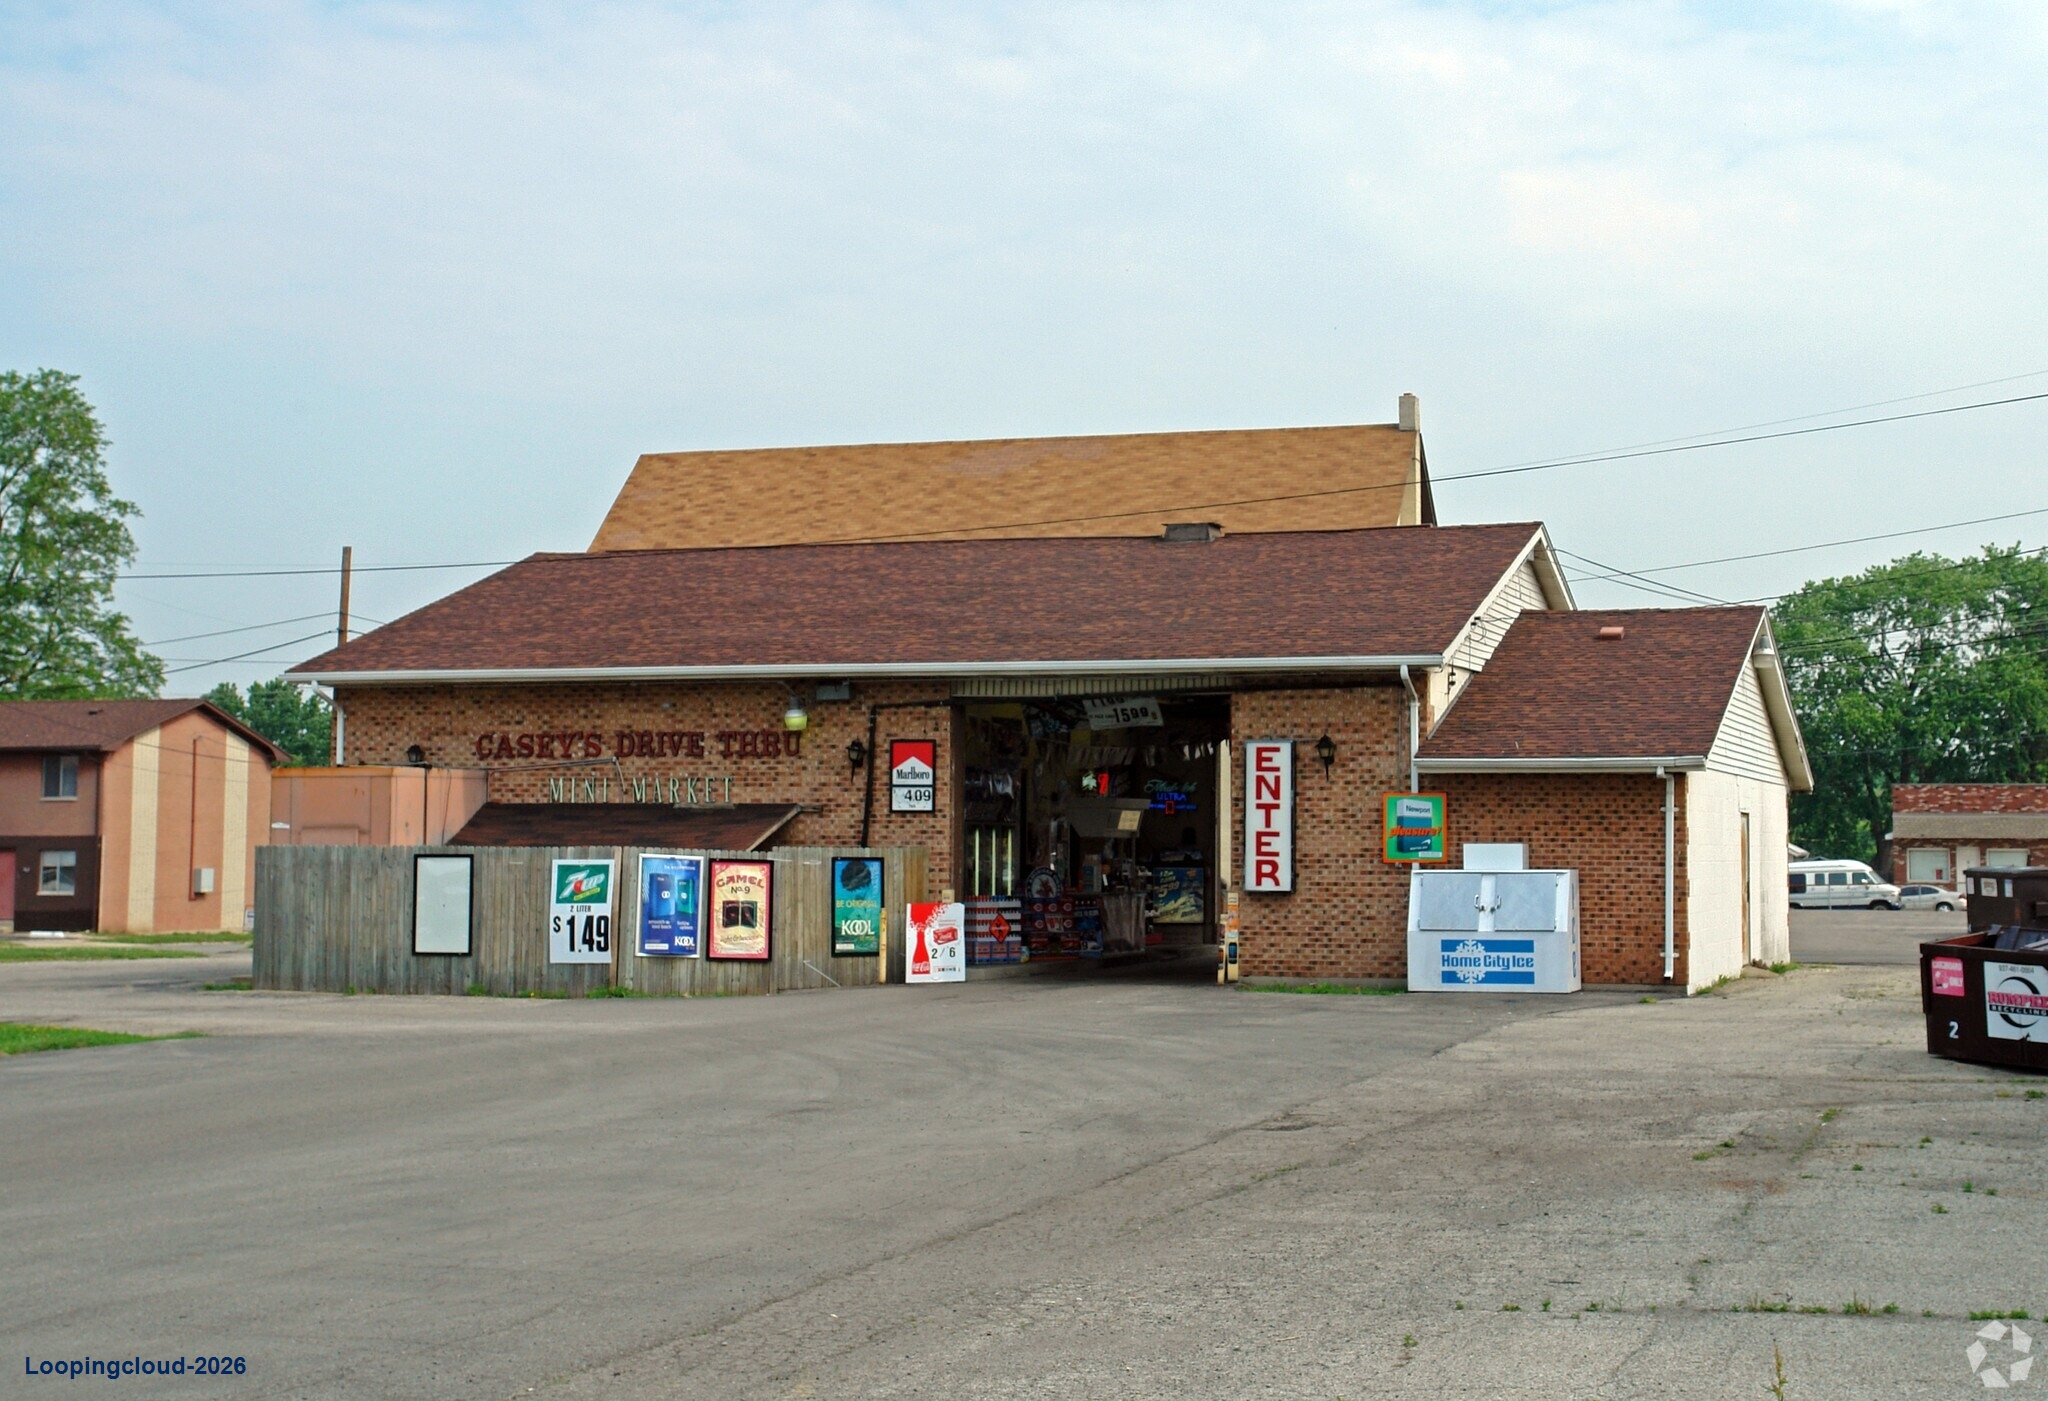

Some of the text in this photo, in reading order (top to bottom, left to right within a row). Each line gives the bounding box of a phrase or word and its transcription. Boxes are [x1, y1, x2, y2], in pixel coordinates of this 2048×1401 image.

[475, 729, 801, 760] CASEY'S DRIVE THRU
[896, 766, 930, 780] Marlboro
[550, 776, 734, 803] MINI MARKET
[1156, 792, 1187, 801] ULTRA
[1405, 804, 1431, 814] Newport
[1255, 747, 1281, 887] ENTER
[716, 874, 765, 889] CAMEL
[744, 886, 751, 894] 9
[841, 919, 876, 936] KOOL
[674, 936, 695, 947] KOOL
[1441, 955, 1534, 970] Home City Ice
[1991, 1005, 2048, 1015] RECYCLING
[1949, 1020, 1959, 1039] 2
